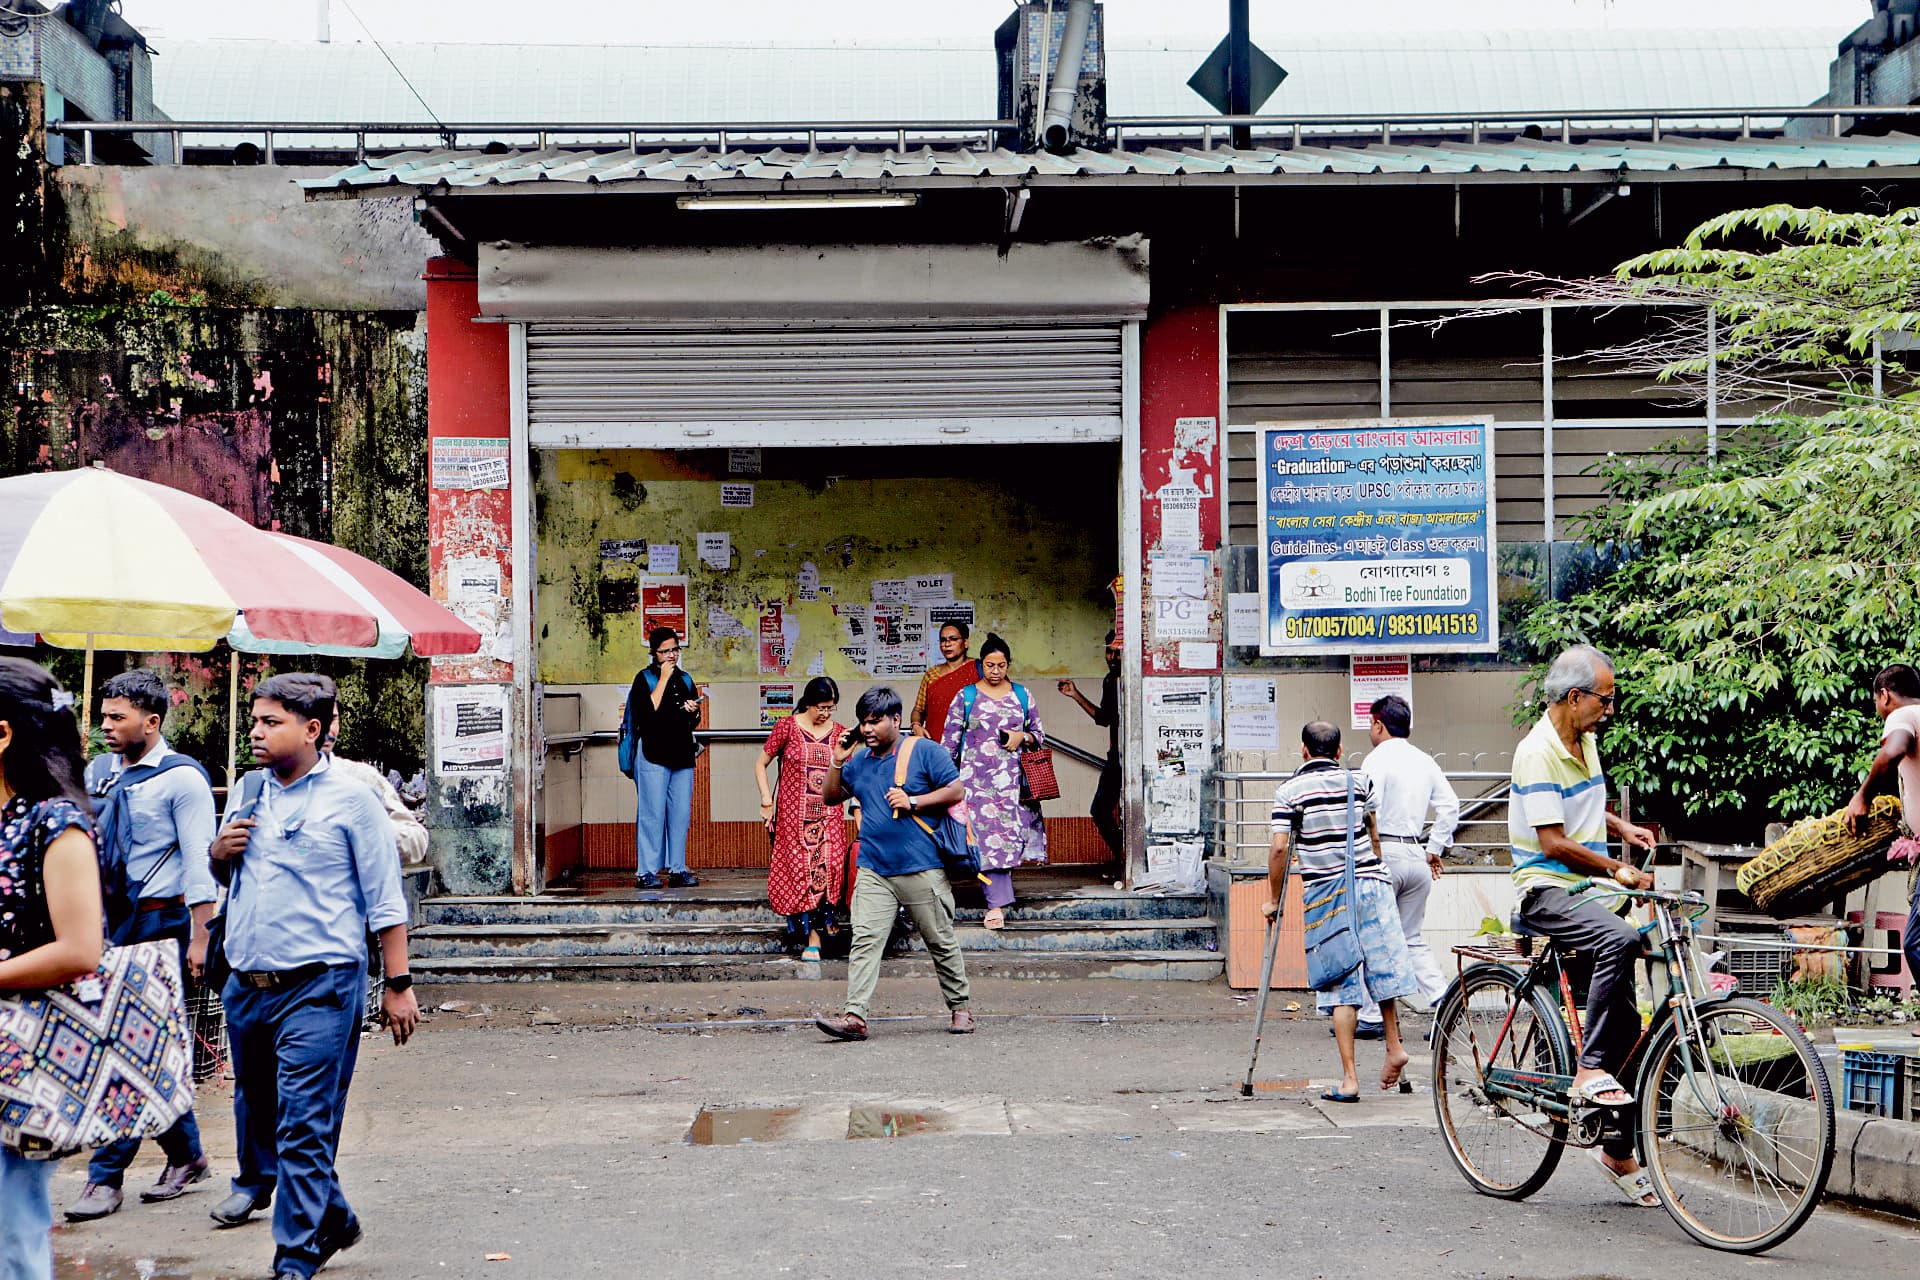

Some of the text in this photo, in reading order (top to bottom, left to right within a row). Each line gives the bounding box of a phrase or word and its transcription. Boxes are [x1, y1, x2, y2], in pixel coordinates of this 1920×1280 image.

[1274, 429, 1480, 453] দেশ গড়বে বাংলার আমলারা
[1379, 454, 1427, 475] পড়াশুনা
[1271, 481, 1300, 502] কেন্দ্রীয়
[1302, 483, 1331, 501] আমলা
[1333, 484, 1353, 501] হতে
[1434, 481, 1461, 498] বসতে
[1313, 513, 1337, 528] সেরা
[1340, 511, 1373, 528] কেন্দ্রীয়
[1376, 513, 1397, 527] এবং
[1344, 540, 1354, 554] এ
[1355, 535, 1388, 555] আজই
[1390, 538, 1424, 552] Class
[1426, 538, 1449, 552] শুরু
[1360, 564, 1436, 579] যোগাযোগ
[916, 579, 943, 588] TO LET
[1345, 586, 1376, 603] Bodhi
[1380, 586, 1403, 602] Tree
[1406, 585, 1467, 602] Foundation
[1157, 600, 1191, 619] PG
[1286, 613, 1478, 638] 9170057004 / 9831041513
[1159, 726, 1204, 738] বিক্ষোভ
